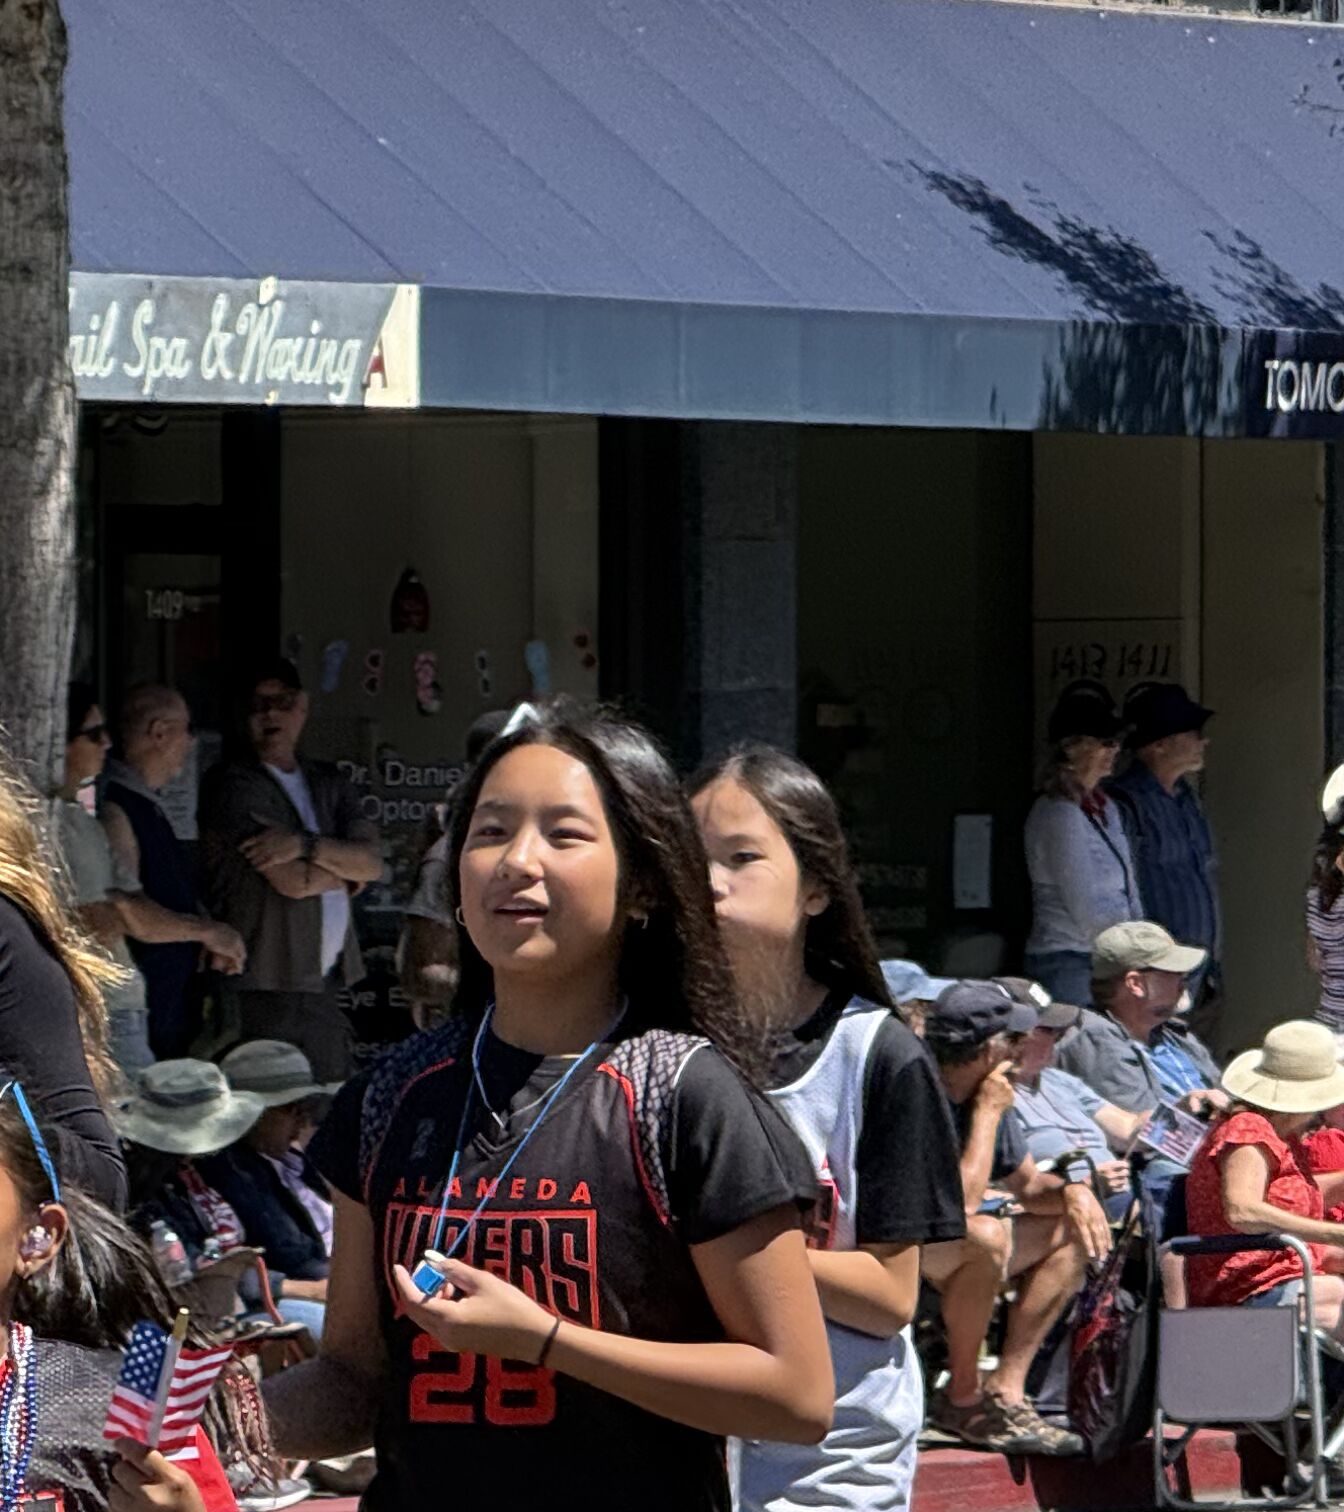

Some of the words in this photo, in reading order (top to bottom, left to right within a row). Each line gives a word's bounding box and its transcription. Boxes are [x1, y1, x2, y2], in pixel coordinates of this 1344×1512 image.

[122, 295, 194, 396] Spa
[199, 292, 237, 383] &
[235, 293, 364, 403] Waxing
[144, 589, 184, 620] 1409
[1117, 642, 1171, 678] 1411
[392, 1175, 593, 1206] ALAMEDA
[410, 1334, 558, 1426] 28
